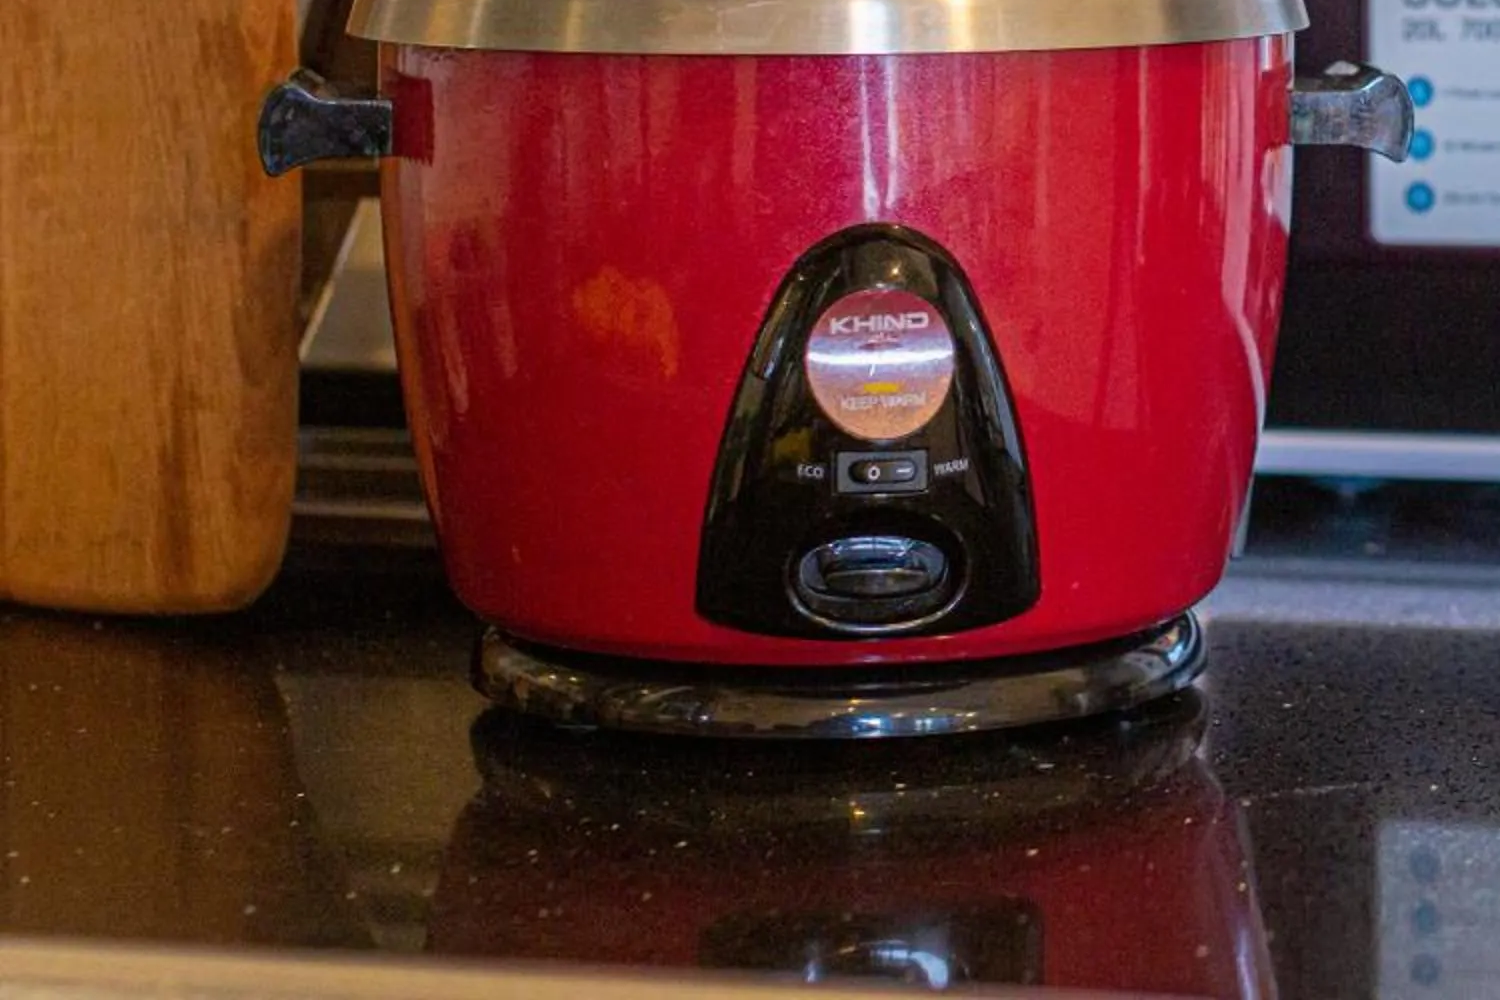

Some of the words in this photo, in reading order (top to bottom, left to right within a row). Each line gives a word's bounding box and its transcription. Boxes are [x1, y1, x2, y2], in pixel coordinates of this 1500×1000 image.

[830, 312, 929, 335] KHIND
[797, 463, 825, 479] ECO
[933, 459, 969, 476] WARM
